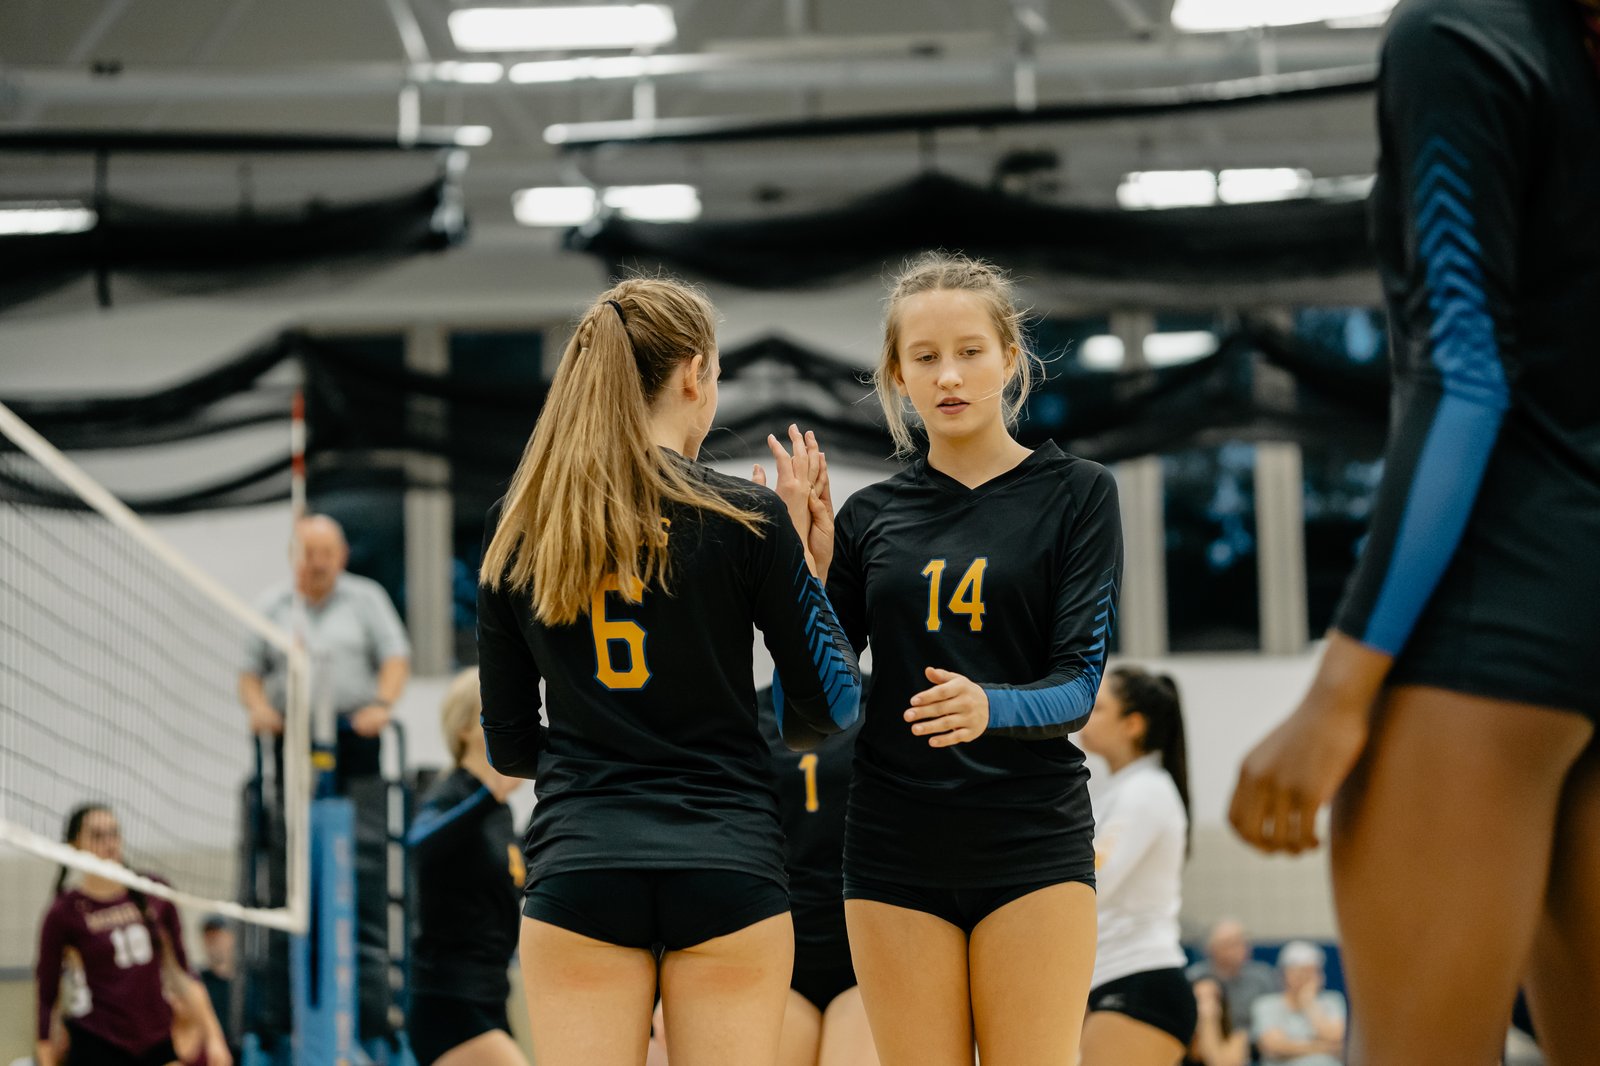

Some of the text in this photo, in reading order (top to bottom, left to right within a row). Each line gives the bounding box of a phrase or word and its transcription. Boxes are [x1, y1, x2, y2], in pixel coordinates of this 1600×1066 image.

[921, 557, 988, 631] 14
[592, 573, 653, 691] 6
[798, 753, 818, 812] 1
